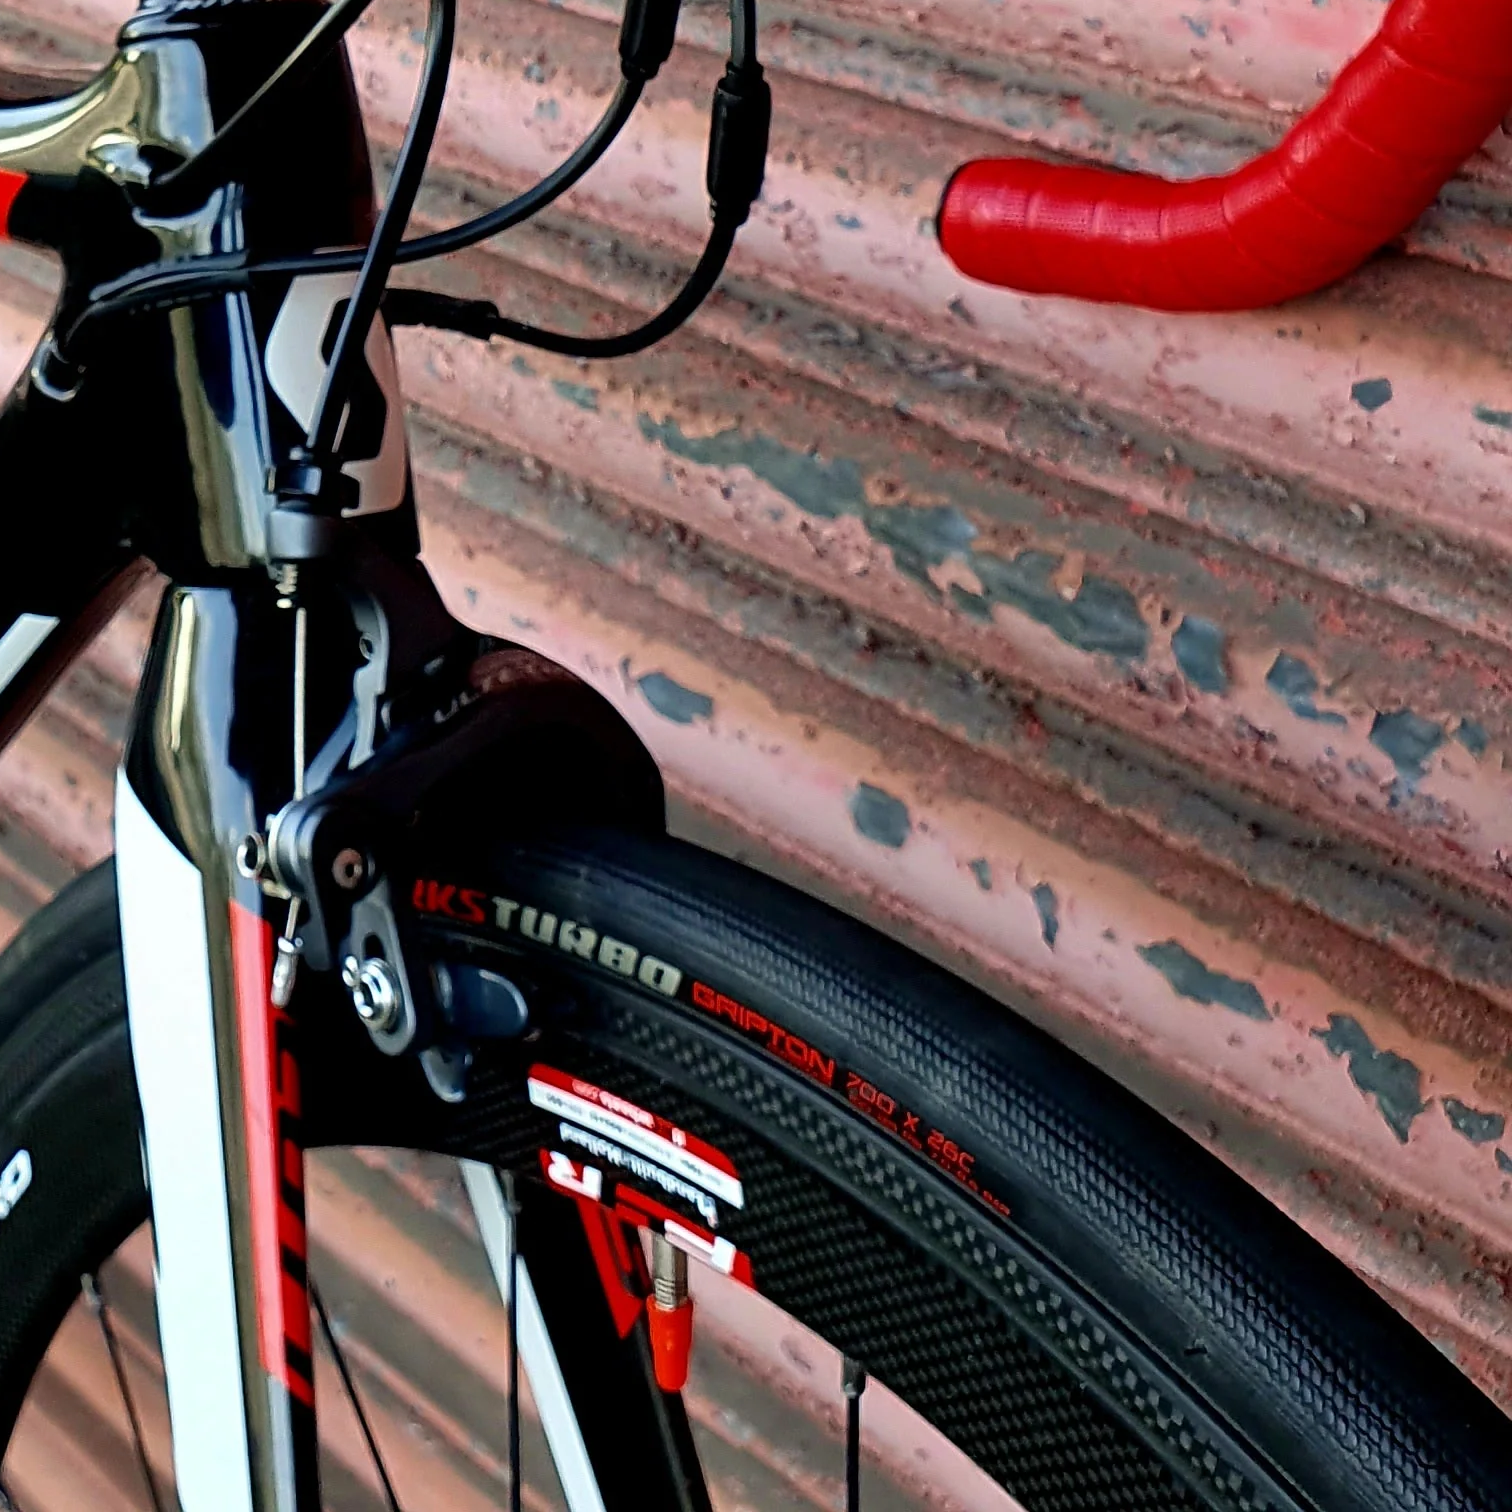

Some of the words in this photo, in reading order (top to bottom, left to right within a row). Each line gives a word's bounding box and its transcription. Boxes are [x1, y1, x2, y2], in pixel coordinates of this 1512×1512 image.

[491, 895, 683, 998] TURBO
[692, 980, 836, 1087] GRIPTON
[846, 1071, 897, 1115] 700
[927, 1128, 976, 1174] 26C
